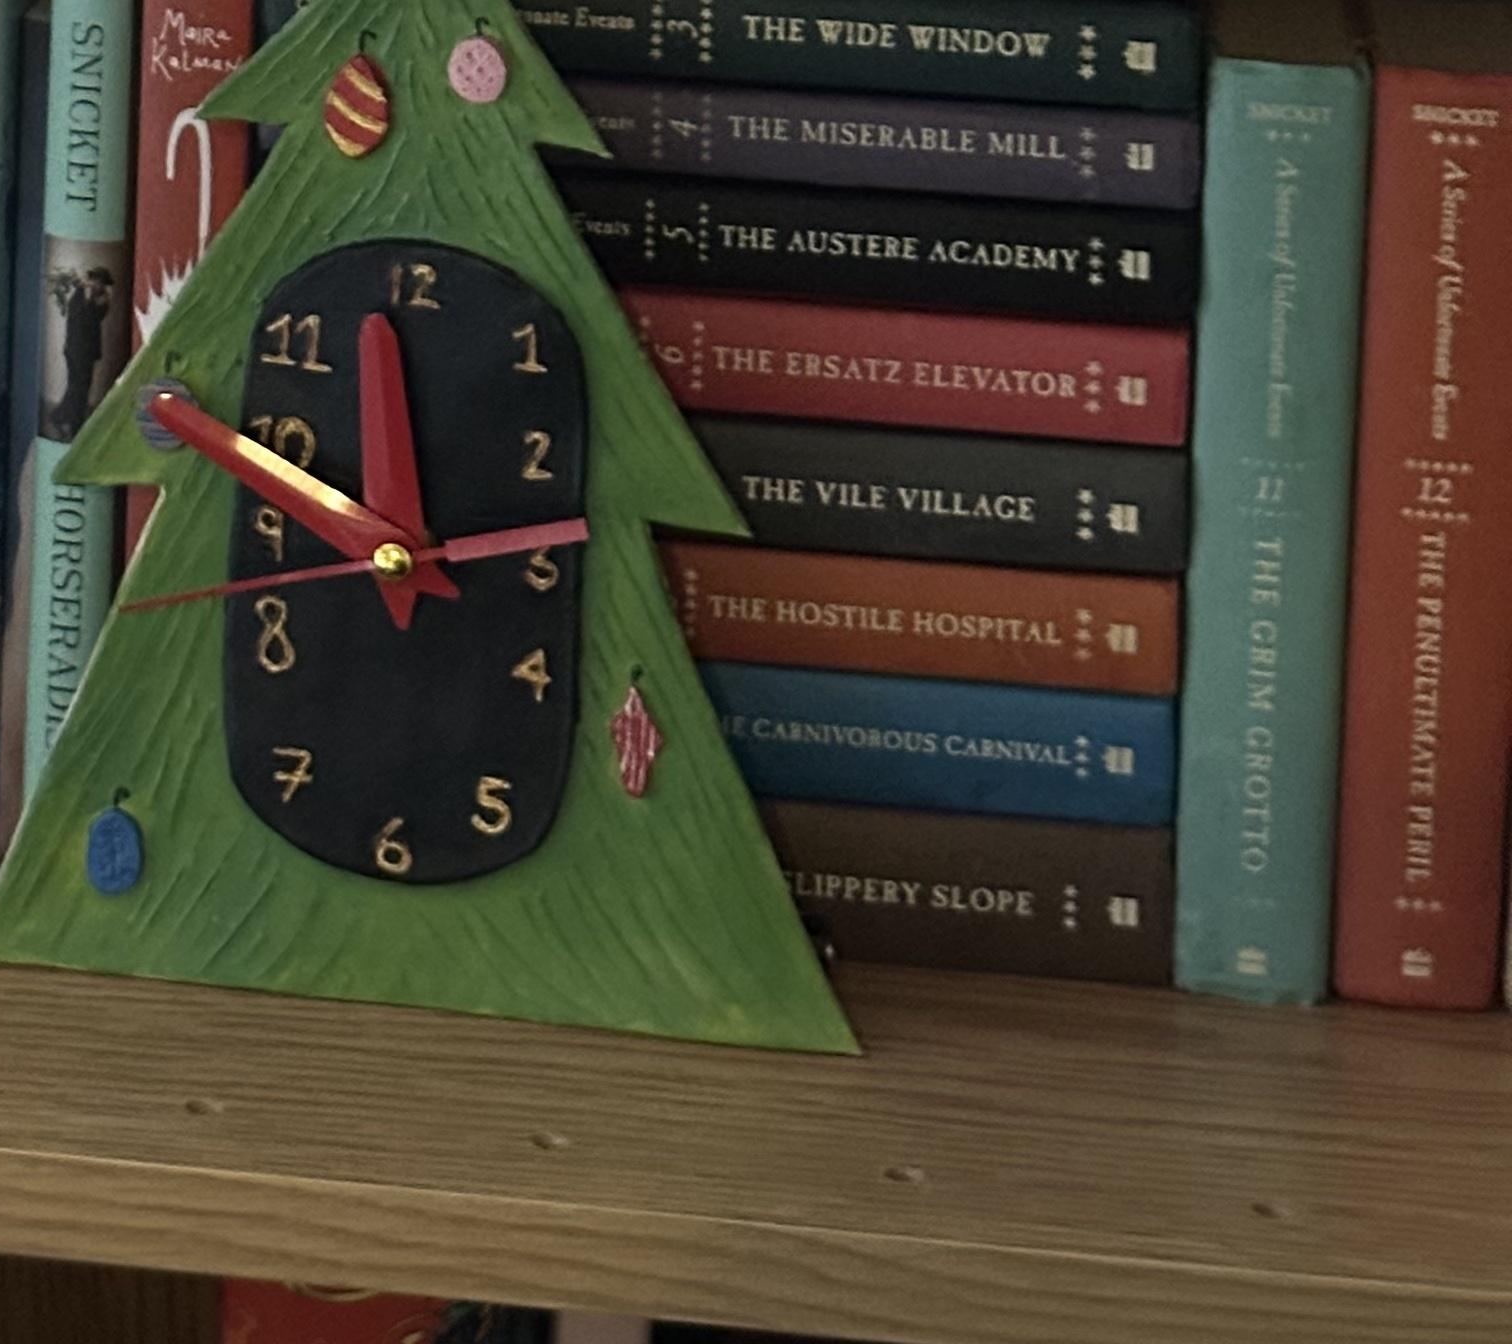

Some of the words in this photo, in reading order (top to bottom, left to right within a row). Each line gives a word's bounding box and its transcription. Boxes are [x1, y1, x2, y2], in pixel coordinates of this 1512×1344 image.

[743, 14, 805, 43] THE
[816, 18, 896, 48] WIDE
[906, 24, 1052, 57] WINDOW
[64, 20, 105, 213] SNICKET
[719, 223, 777, 251] THE
[787, 228, 920, 261] AUSTERE
[928, 238, 1080, 272] ACADEMY
[389, 261, 441, 310] 12
[260, 312, 334, 374] 11
[742, 474, 804, 504] THE
[814, 479, 887, 509] VILE
[896, 488, 1036, 523] VILLAGE
[254, 596, 296, 674] 8
[272, 746, 314, 803] 7
[470, 775, 514, 835] 5
